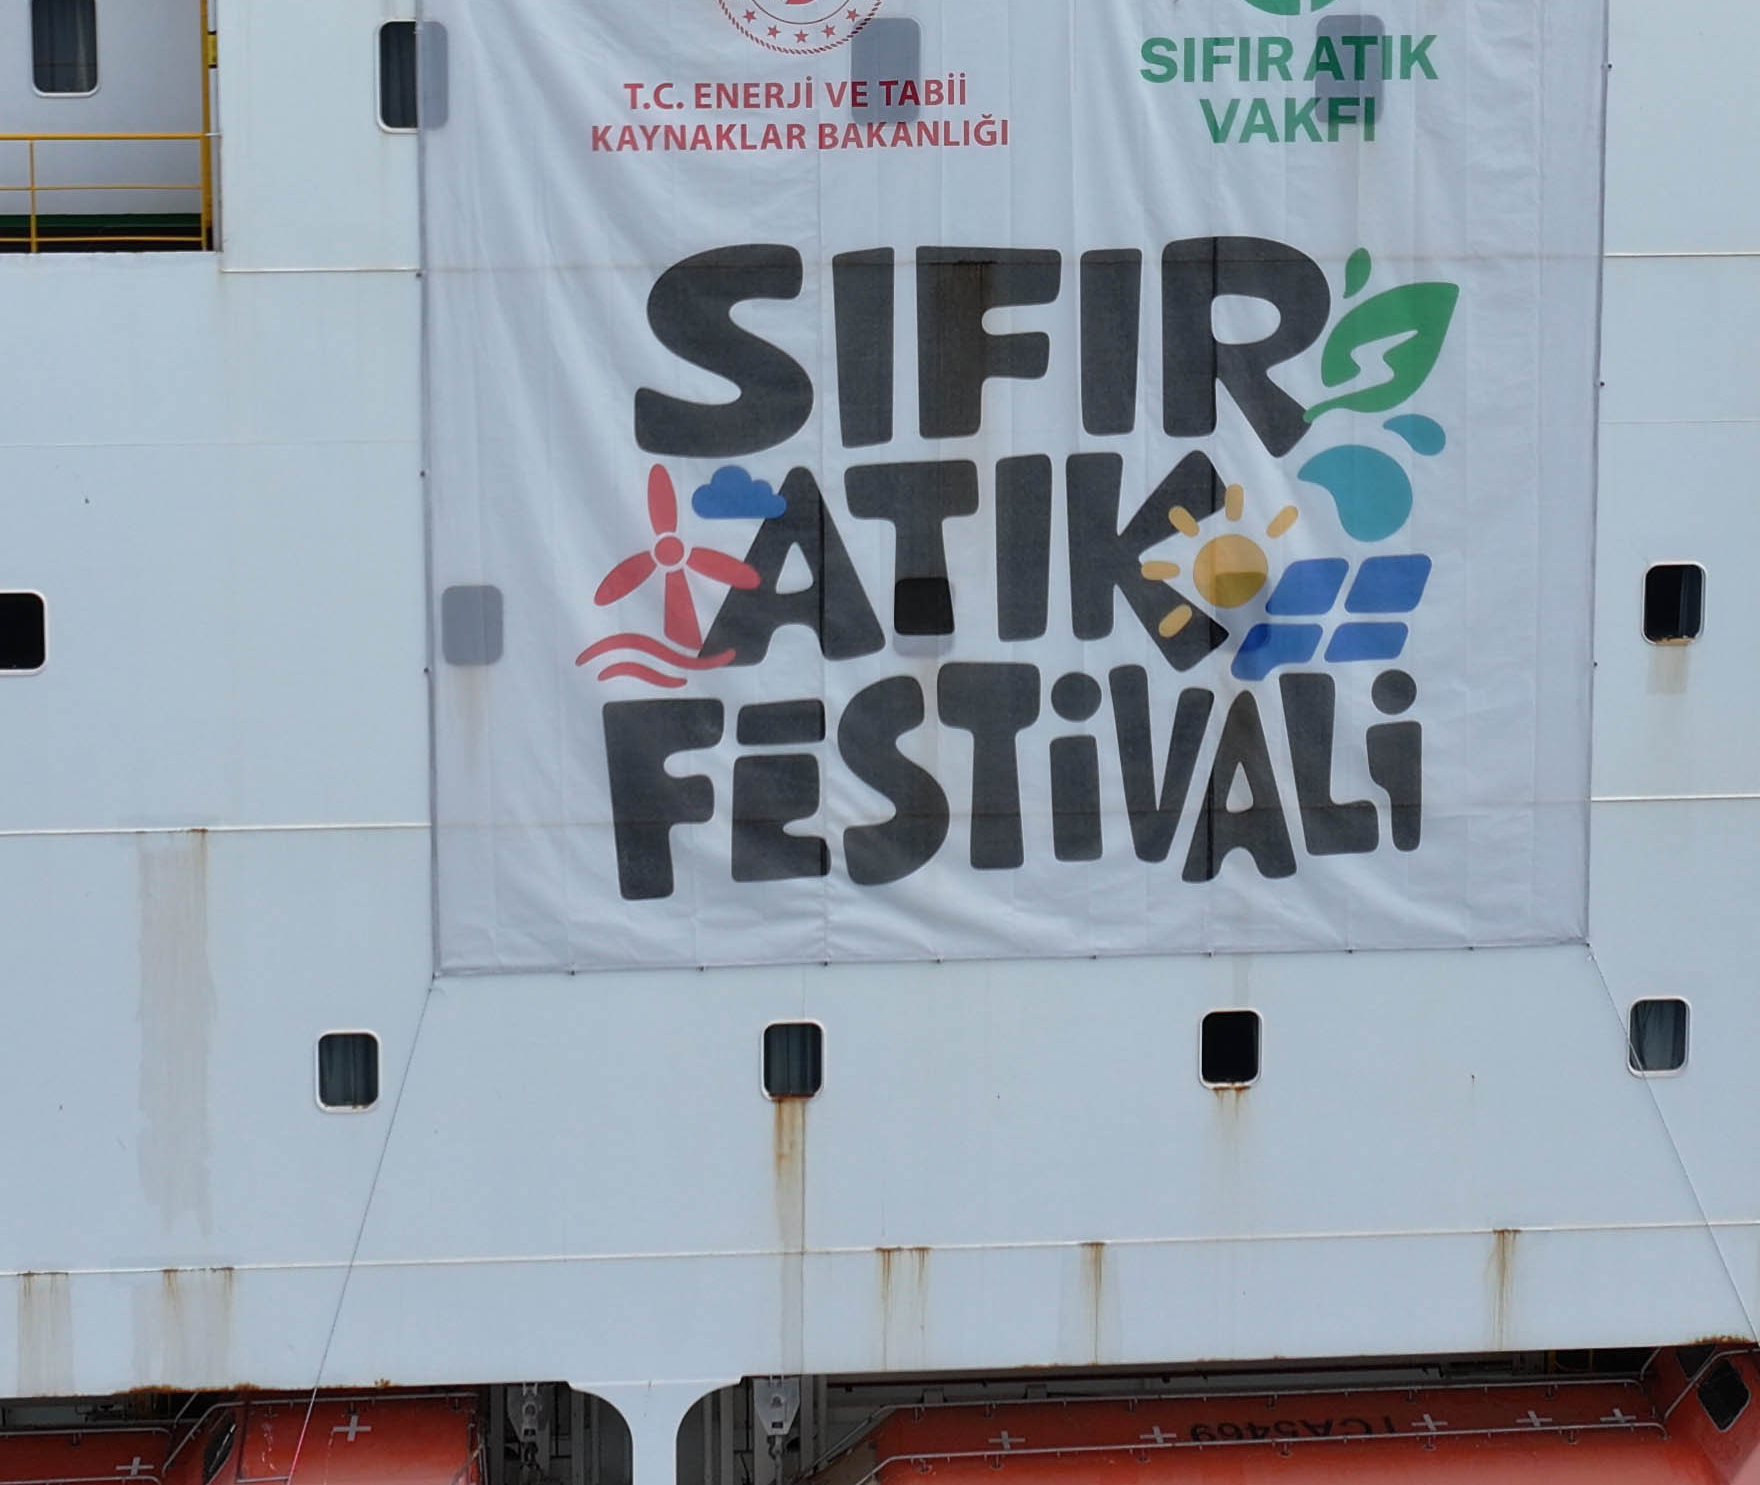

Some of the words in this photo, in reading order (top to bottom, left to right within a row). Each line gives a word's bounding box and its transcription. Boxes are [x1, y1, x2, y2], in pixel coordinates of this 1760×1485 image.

[1140, 36, 1293, 83] SIFIR
[1303, 35, 1438, 80] ATIK
[624, 82, 683, 110] T.C.
[695, 76, 813, 108] ENERJİ
[825, 81, 868, 107] VE
[879, 73, 967, 106] TABİİ
[592, 123, 806, 152] KAYNAKLAR
[818, 114, 1009, 149] BAKANLIĞI
[1199, 96, 1375, 143] VAKFI
[634, 235, 1330, 458] SIFIR
[698, 449, 1228, 673] ATIK
